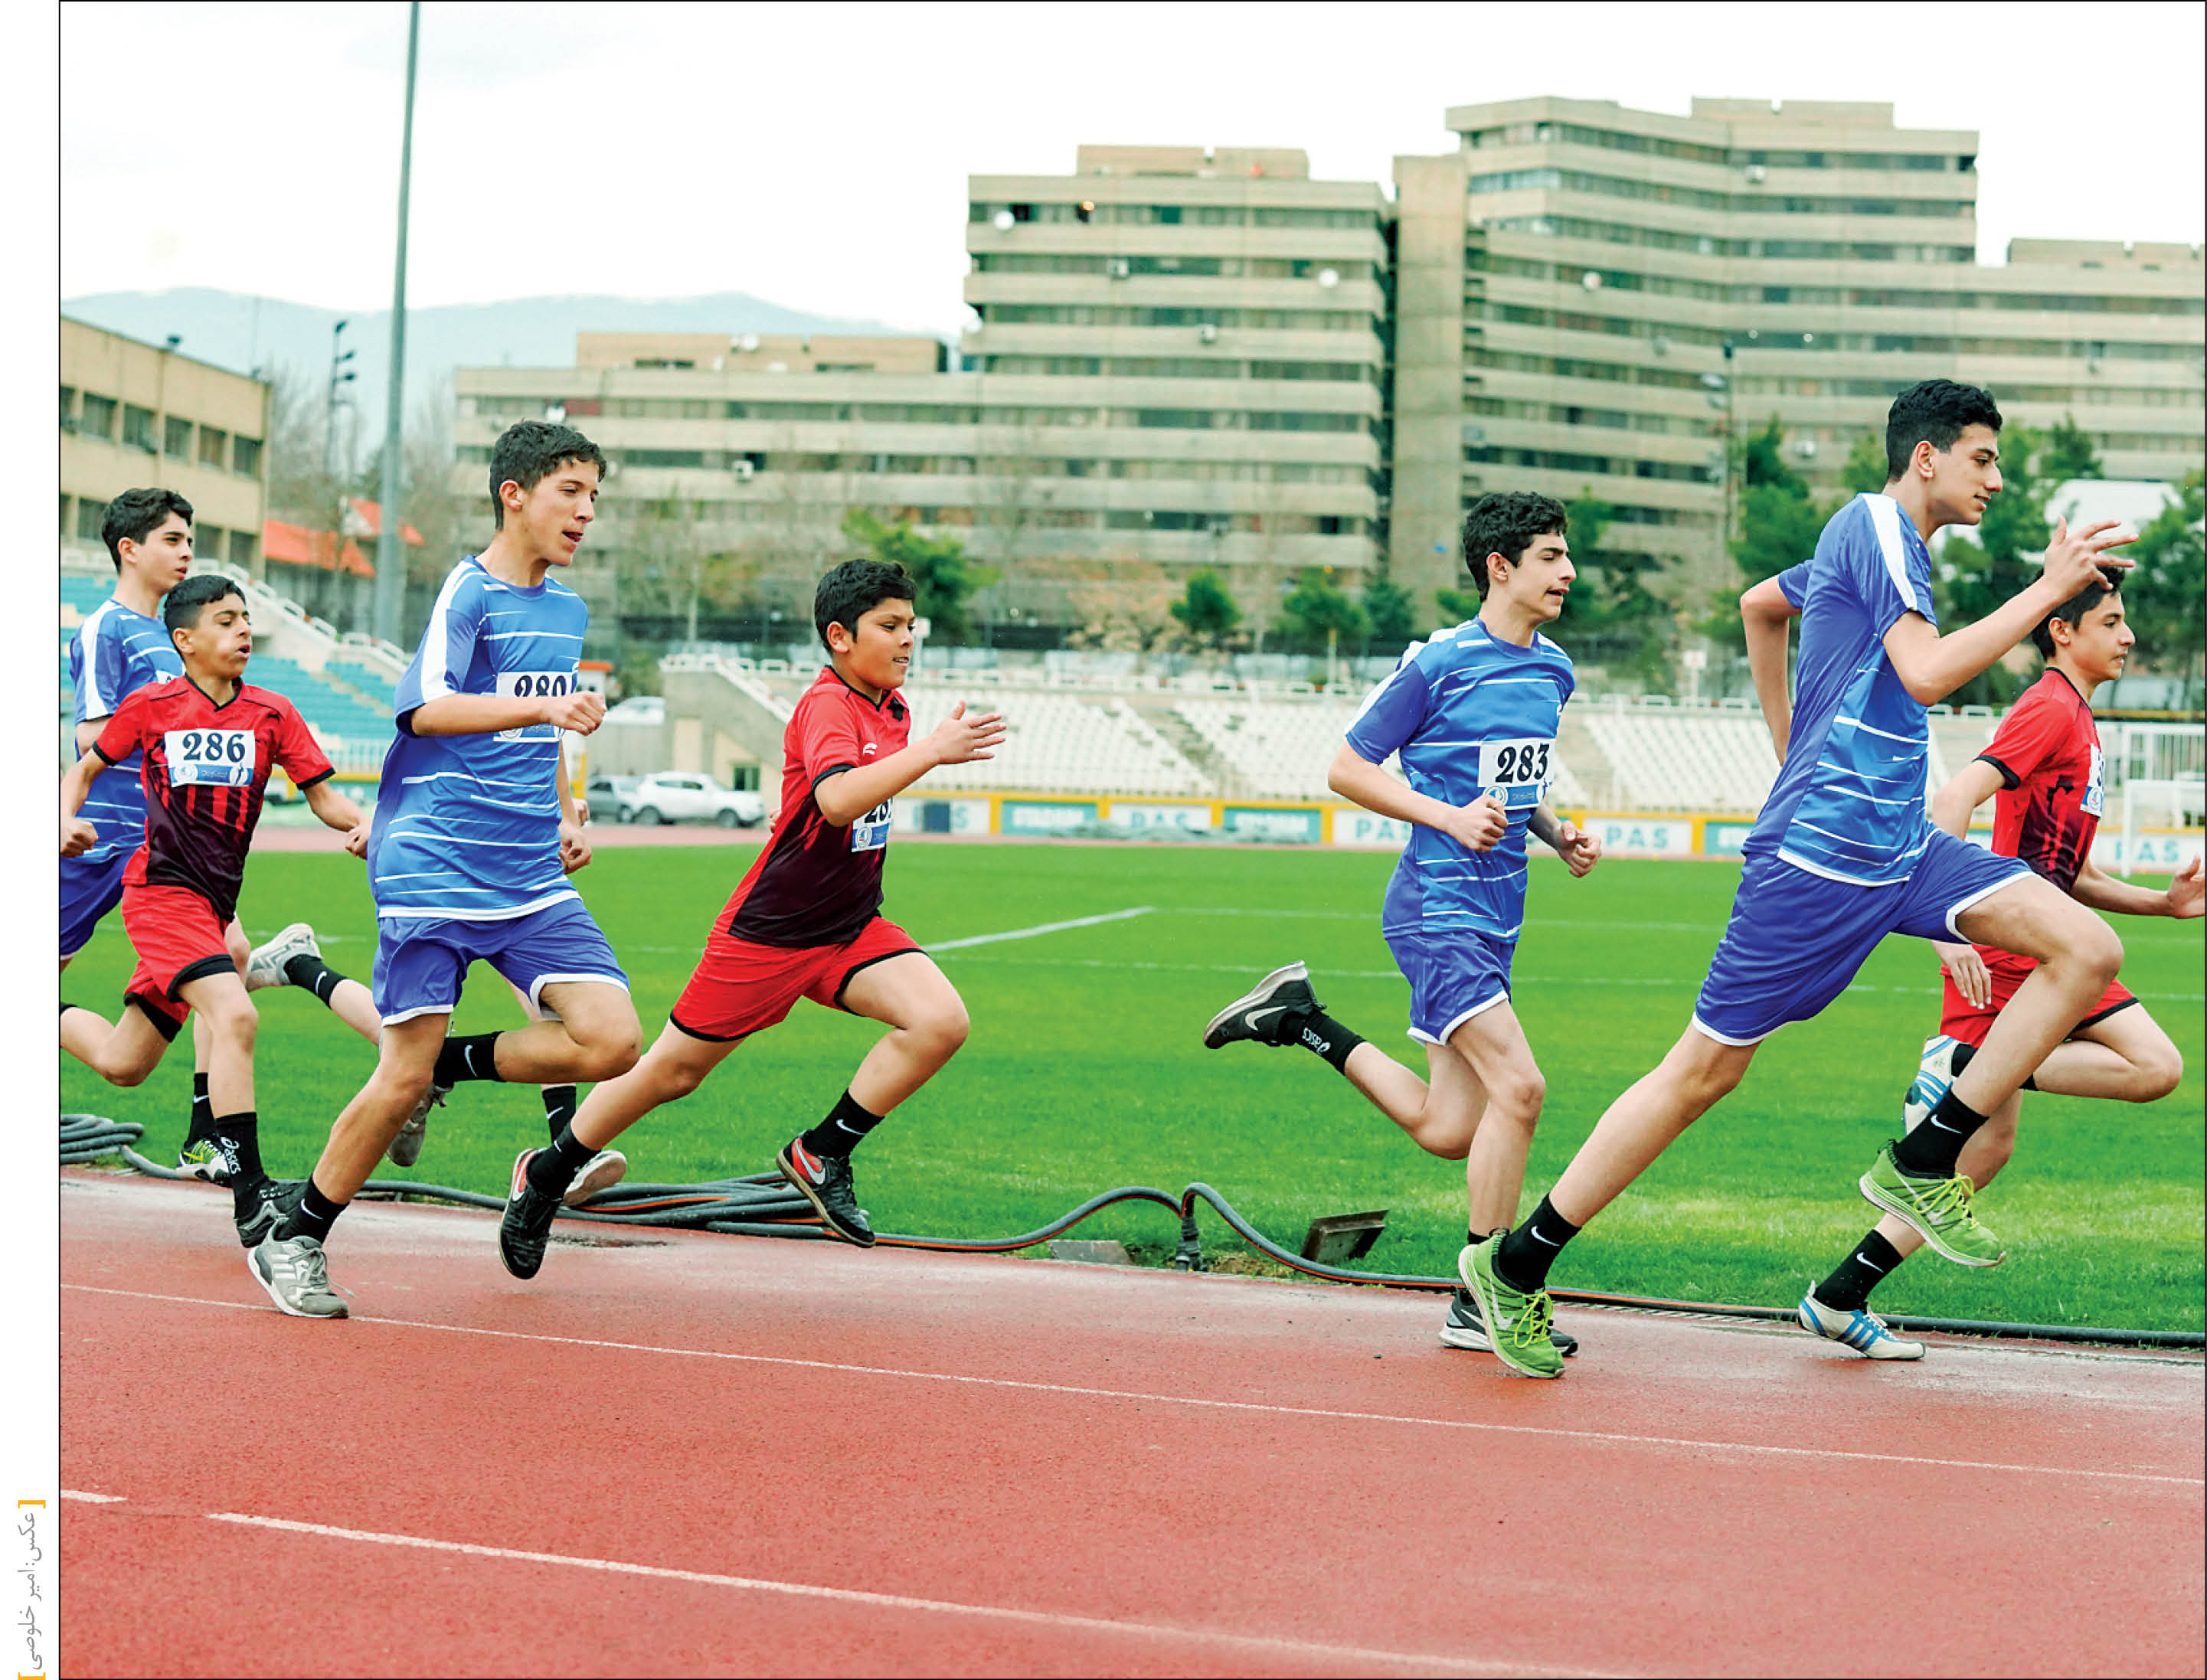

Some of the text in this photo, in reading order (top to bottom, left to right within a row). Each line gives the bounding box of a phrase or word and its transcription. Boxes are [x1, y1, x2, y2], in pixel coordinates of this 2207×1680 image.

[182, 733, 246, 763] 286
[1495, 743, 1550, 783] 283
[1606, 826, 1668, 848] PAS
